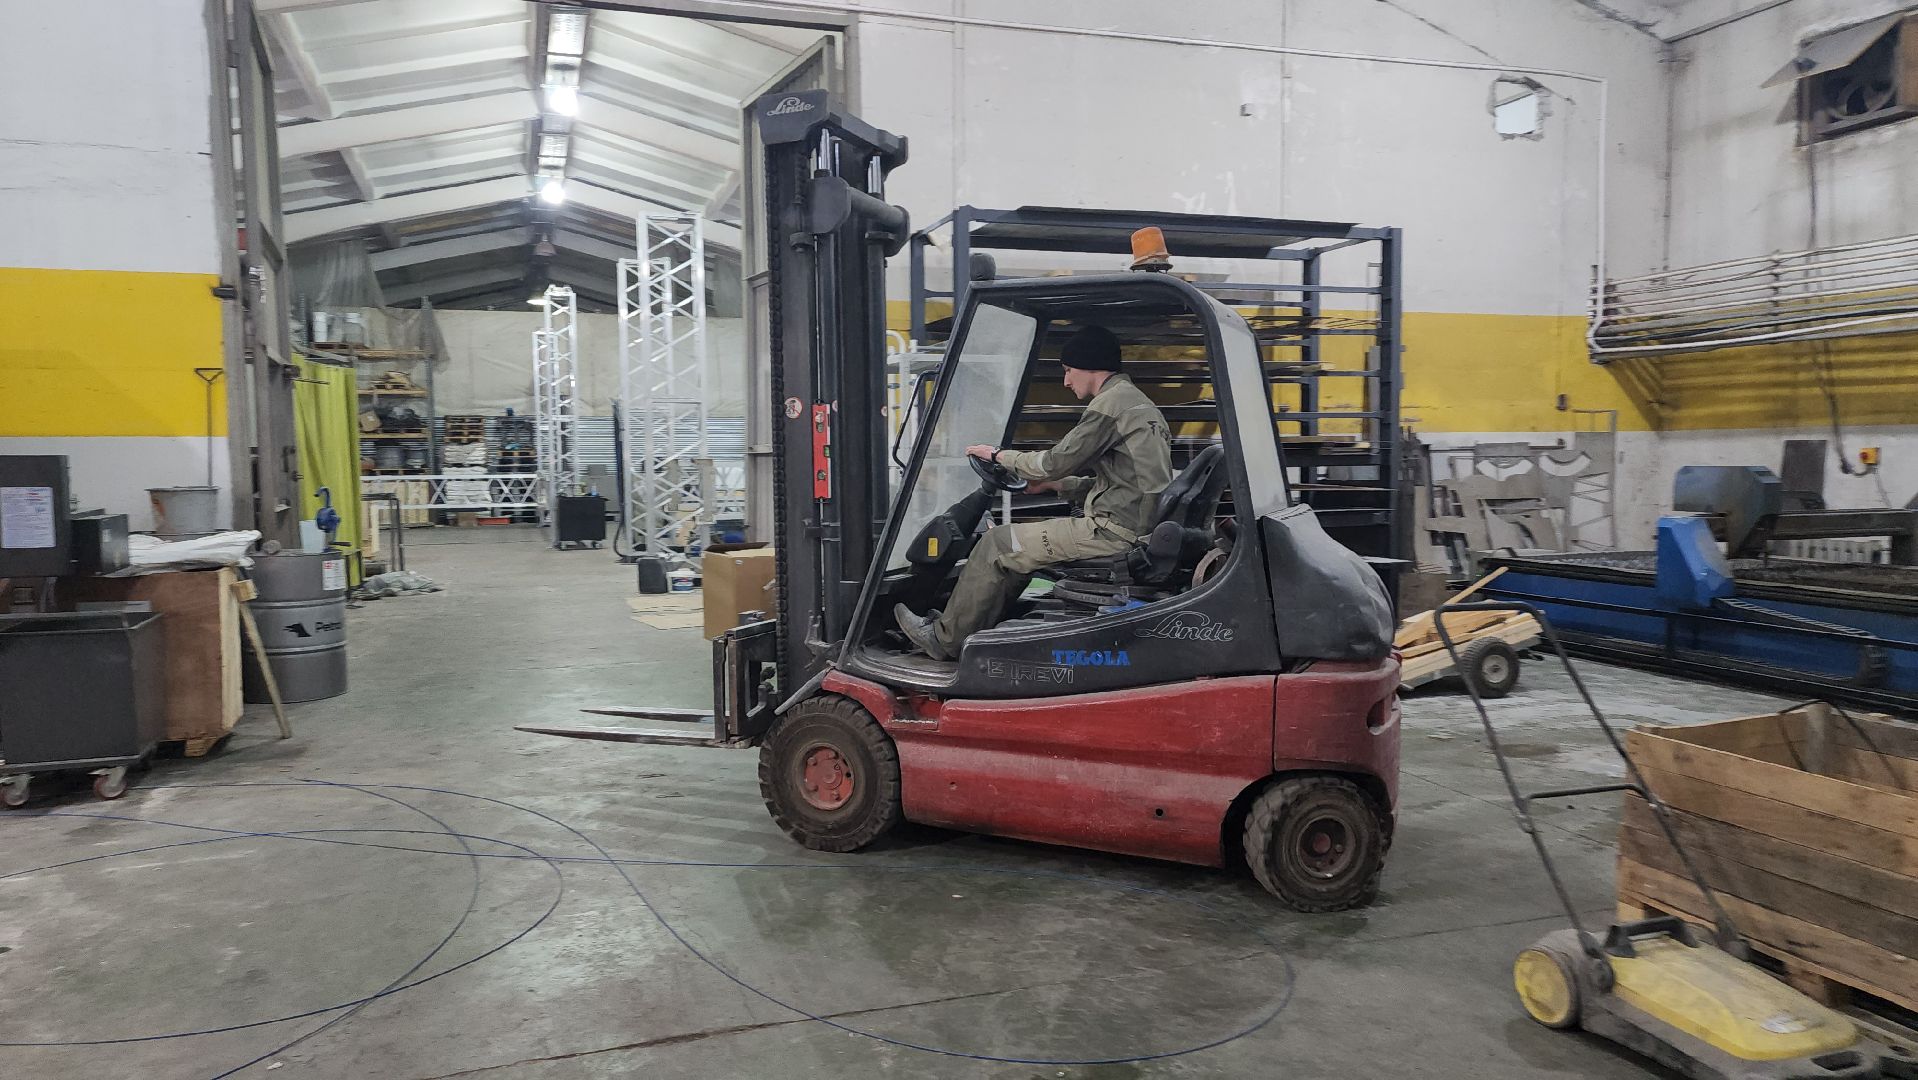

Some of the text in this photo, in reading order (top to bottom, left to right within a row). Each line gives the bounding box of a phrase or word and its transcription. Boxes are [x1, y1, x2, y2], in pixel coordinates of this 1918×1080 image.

[767, 97, 814, 116] Linde
[1134, 610, 1234, 642] Linde
[1052, 649, 1131, 666] TEGOLA
